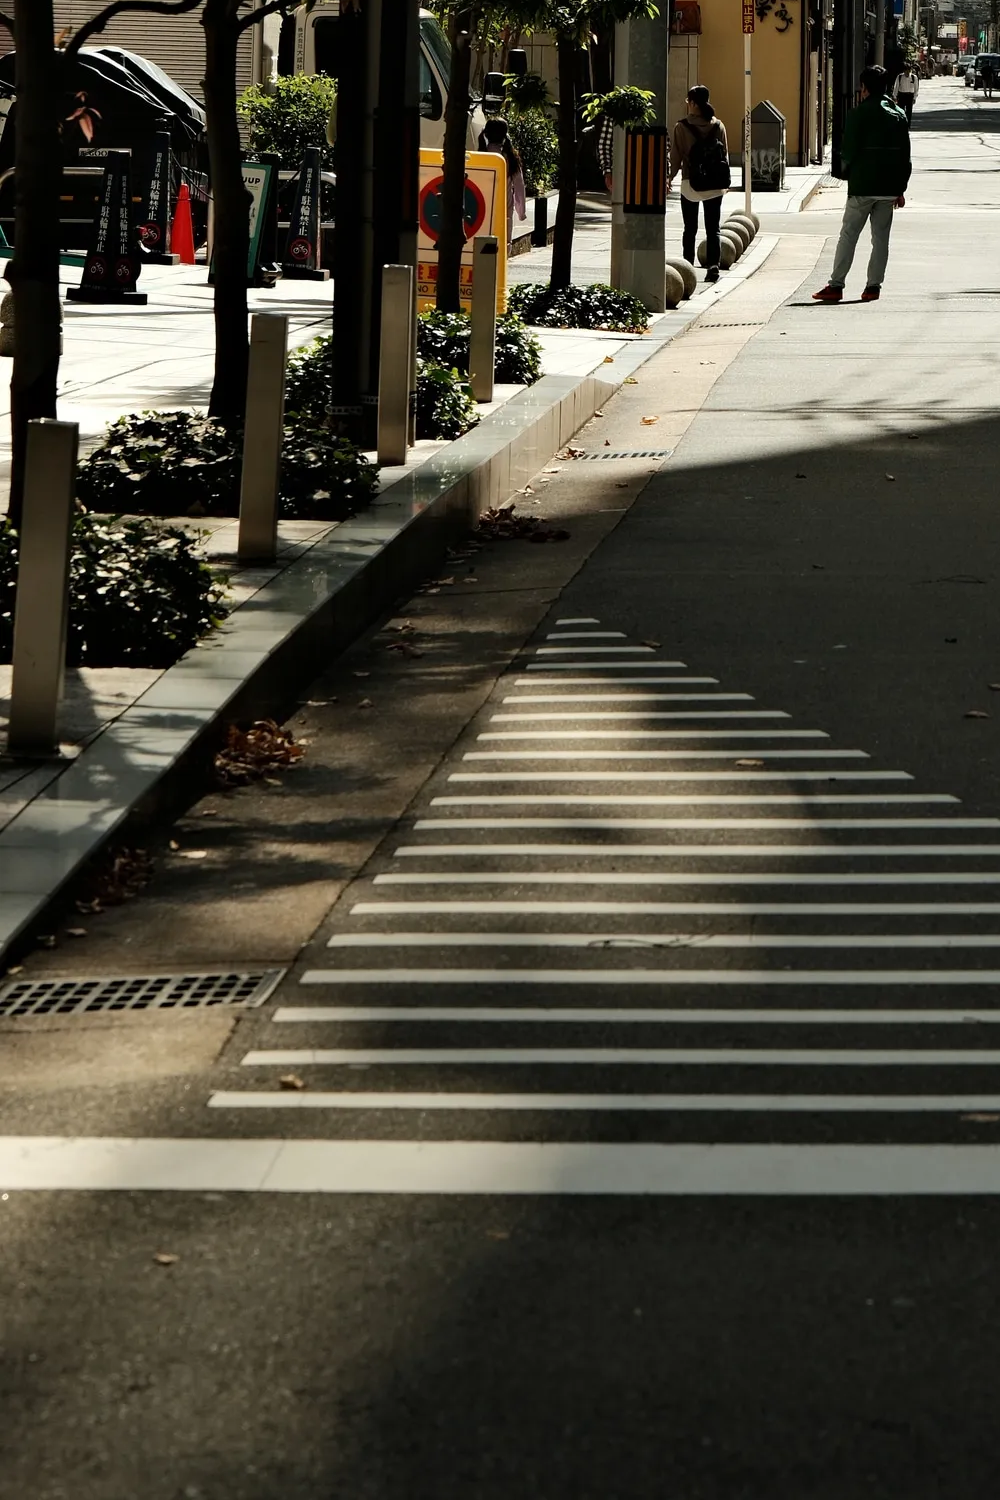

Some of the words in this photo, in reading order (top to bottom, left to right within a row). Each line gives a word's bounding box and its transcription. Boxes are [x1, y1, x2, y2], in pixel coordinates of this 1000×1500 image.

[147, 179, 162, 221] 駐輪禁止
[242, 177, 261, 185] UUP
[95, 205, 111, 254] 駐輪禁止
[119, 206, 129, 255] 駐輪禁止
[298, 195, 312, 237] 駐輪禁止
